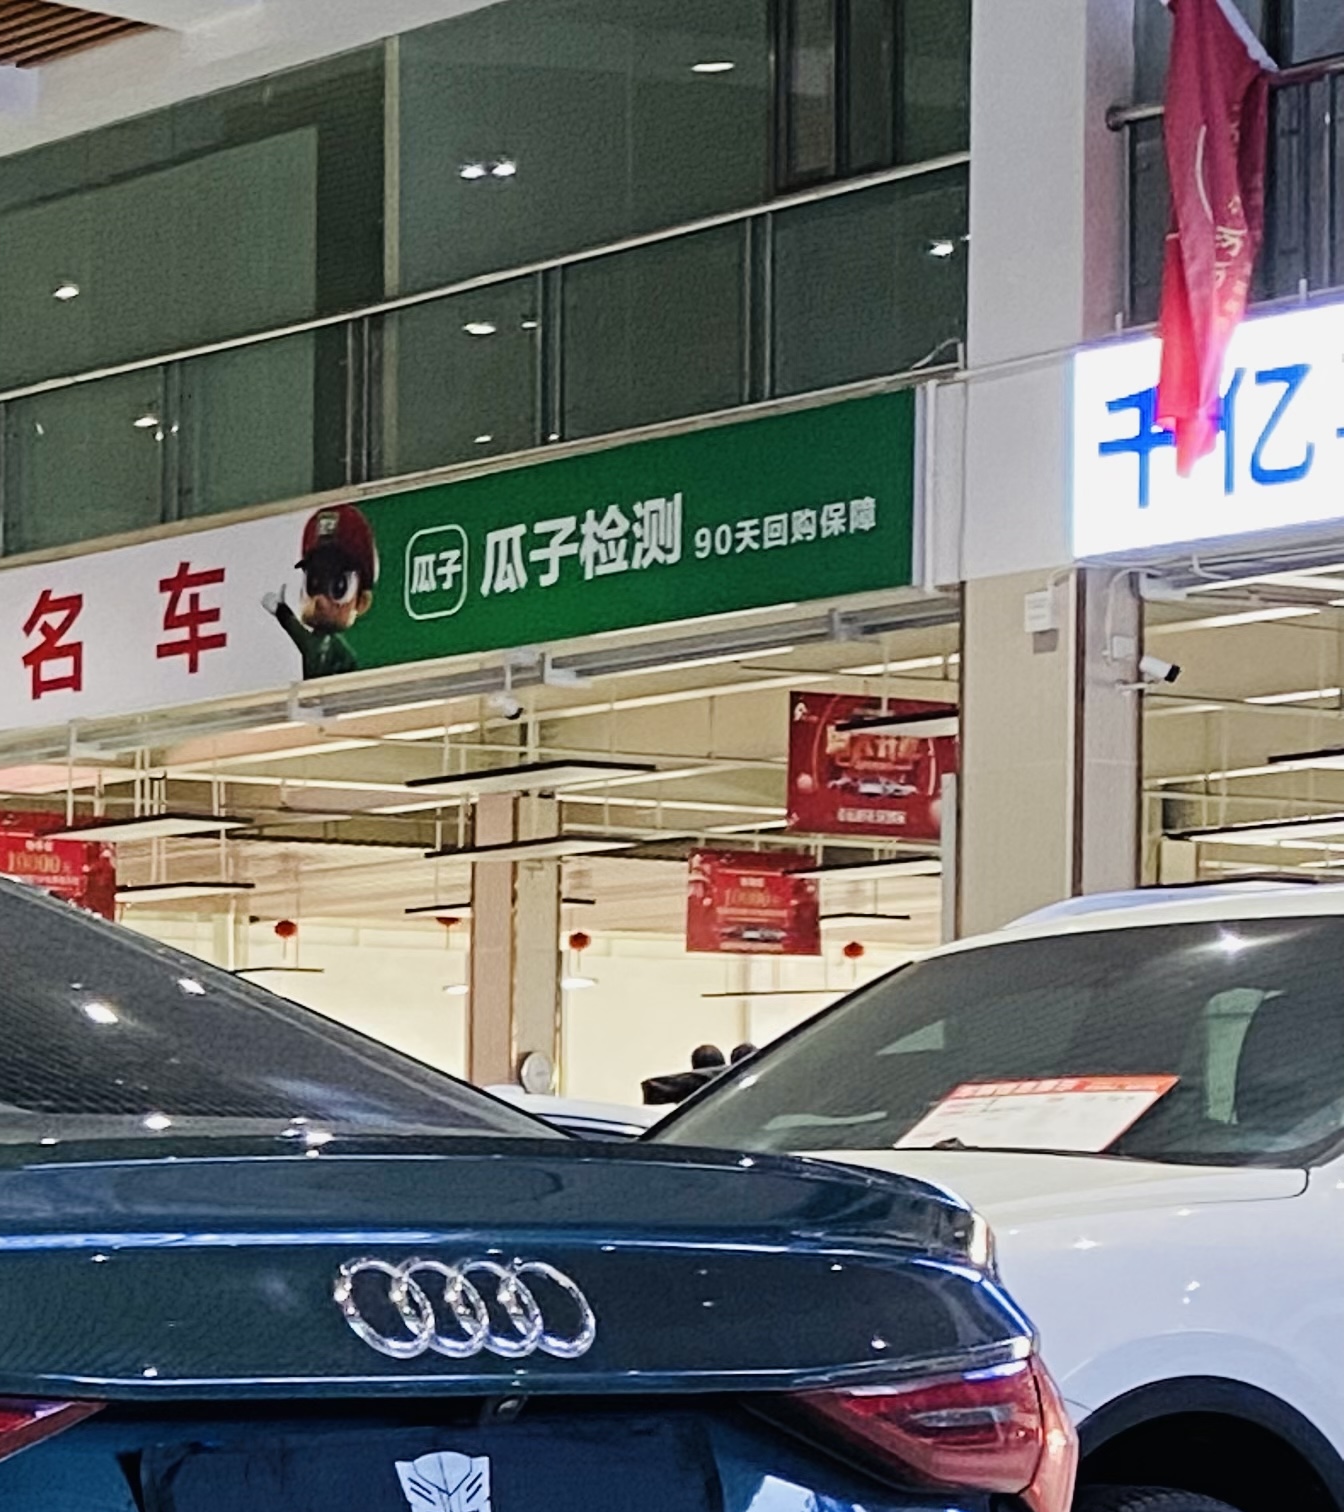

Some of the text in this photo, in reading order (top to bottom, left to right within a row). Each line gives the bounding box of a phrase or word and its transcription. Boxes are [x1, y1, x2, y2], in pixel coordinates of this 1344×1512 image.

[1098, 363, 1344, 508] 千亿
[410, 549, 462, 595] 瓜子
[480, 492, 877, 598] 瓜子检测 90天回购保障
